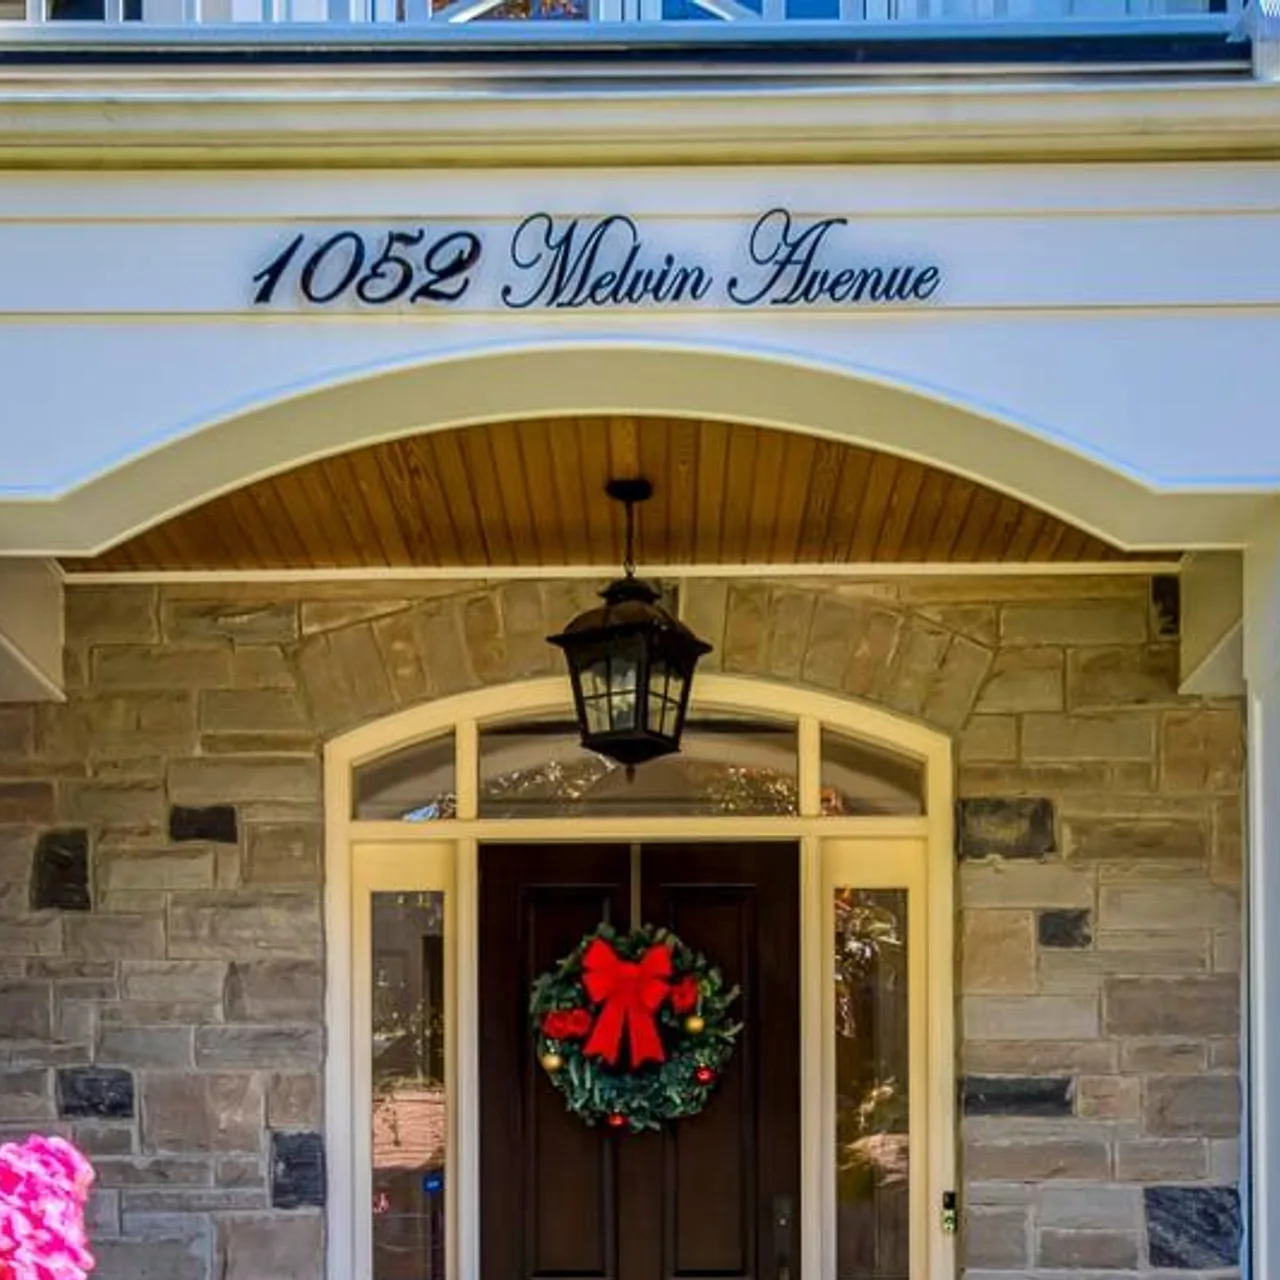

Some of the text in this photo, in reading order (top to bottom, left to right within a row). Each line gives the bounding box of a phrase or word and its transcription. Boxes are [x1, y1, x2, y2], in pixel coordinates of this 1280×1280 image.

[253, 208, 941, 308] 1052 Melvin Avenue
